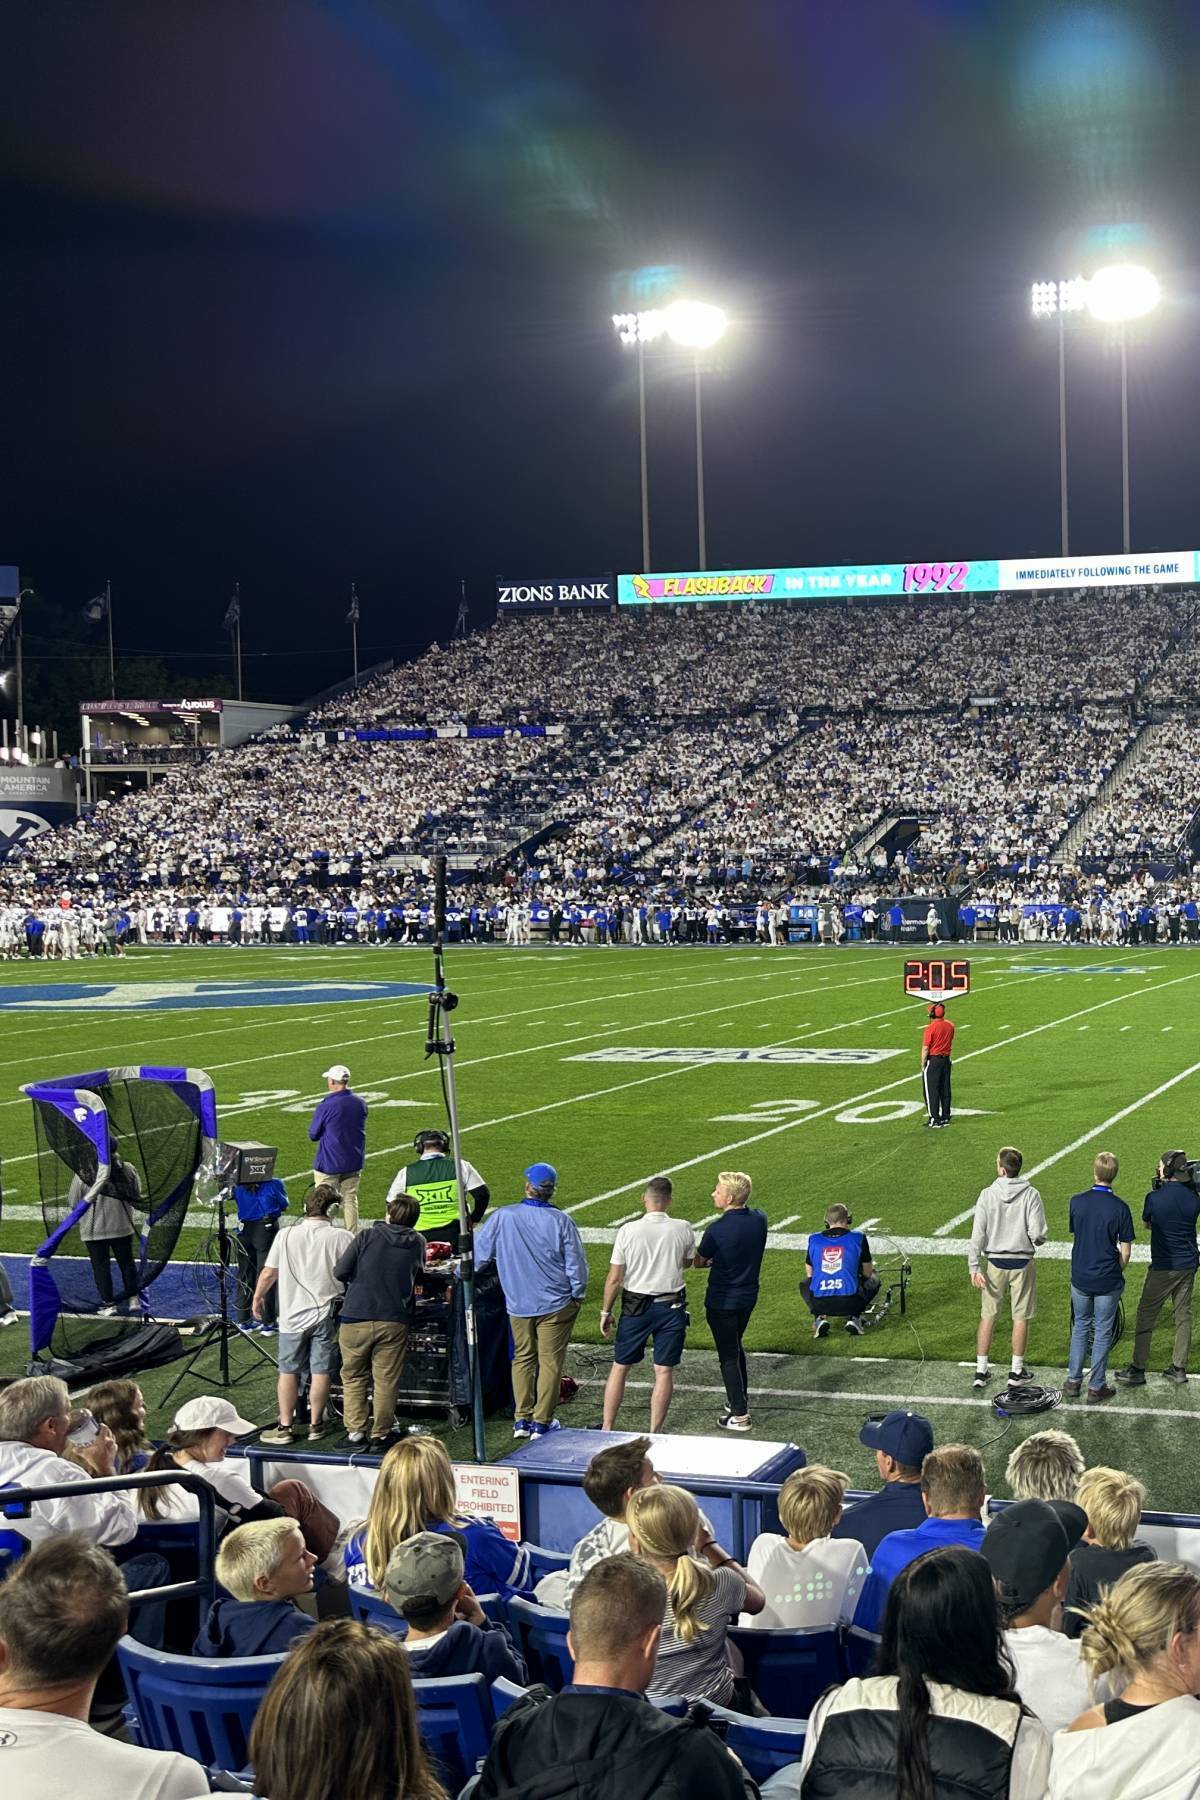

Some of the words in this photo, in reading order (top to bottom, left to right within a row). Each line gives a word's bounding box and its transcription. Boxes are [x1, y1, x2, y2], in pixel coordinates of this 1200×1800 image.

[1015, 569, 1077, 580] IMMEDIATELY
[1078, 566, 1132, 577] FOLLOWING
[1133, 565, 1151, 575] THE
[1153, 563, 1180, 574] GAME
[662, 576, 768, 597] FLASHBACK
[785, 577, 804, 590] IN
[809, 575, 840, 589] THE
[849, 573, 892, 588] YEAR
[902, 562, 971, 592] 1992
[498, 586, 554, 603] ZIONS
[559, 584, 610, 601] BANK
[0, 776, 50, 784] MOUNTAIN
[4, 784, 47, 792] AMERICA
[906, 961, 968, 991] 2:05
[641, 1050, 879, 1062] PACS
[707, 1099, 926, 1124] 20
[820, 1278, 843, 1290] 125
[460, 1474, 509, 1487] ENTERING
[471, 1489, 499, 1499] FIELD
[457, 1501, 514, 1513] PROHIBITED
